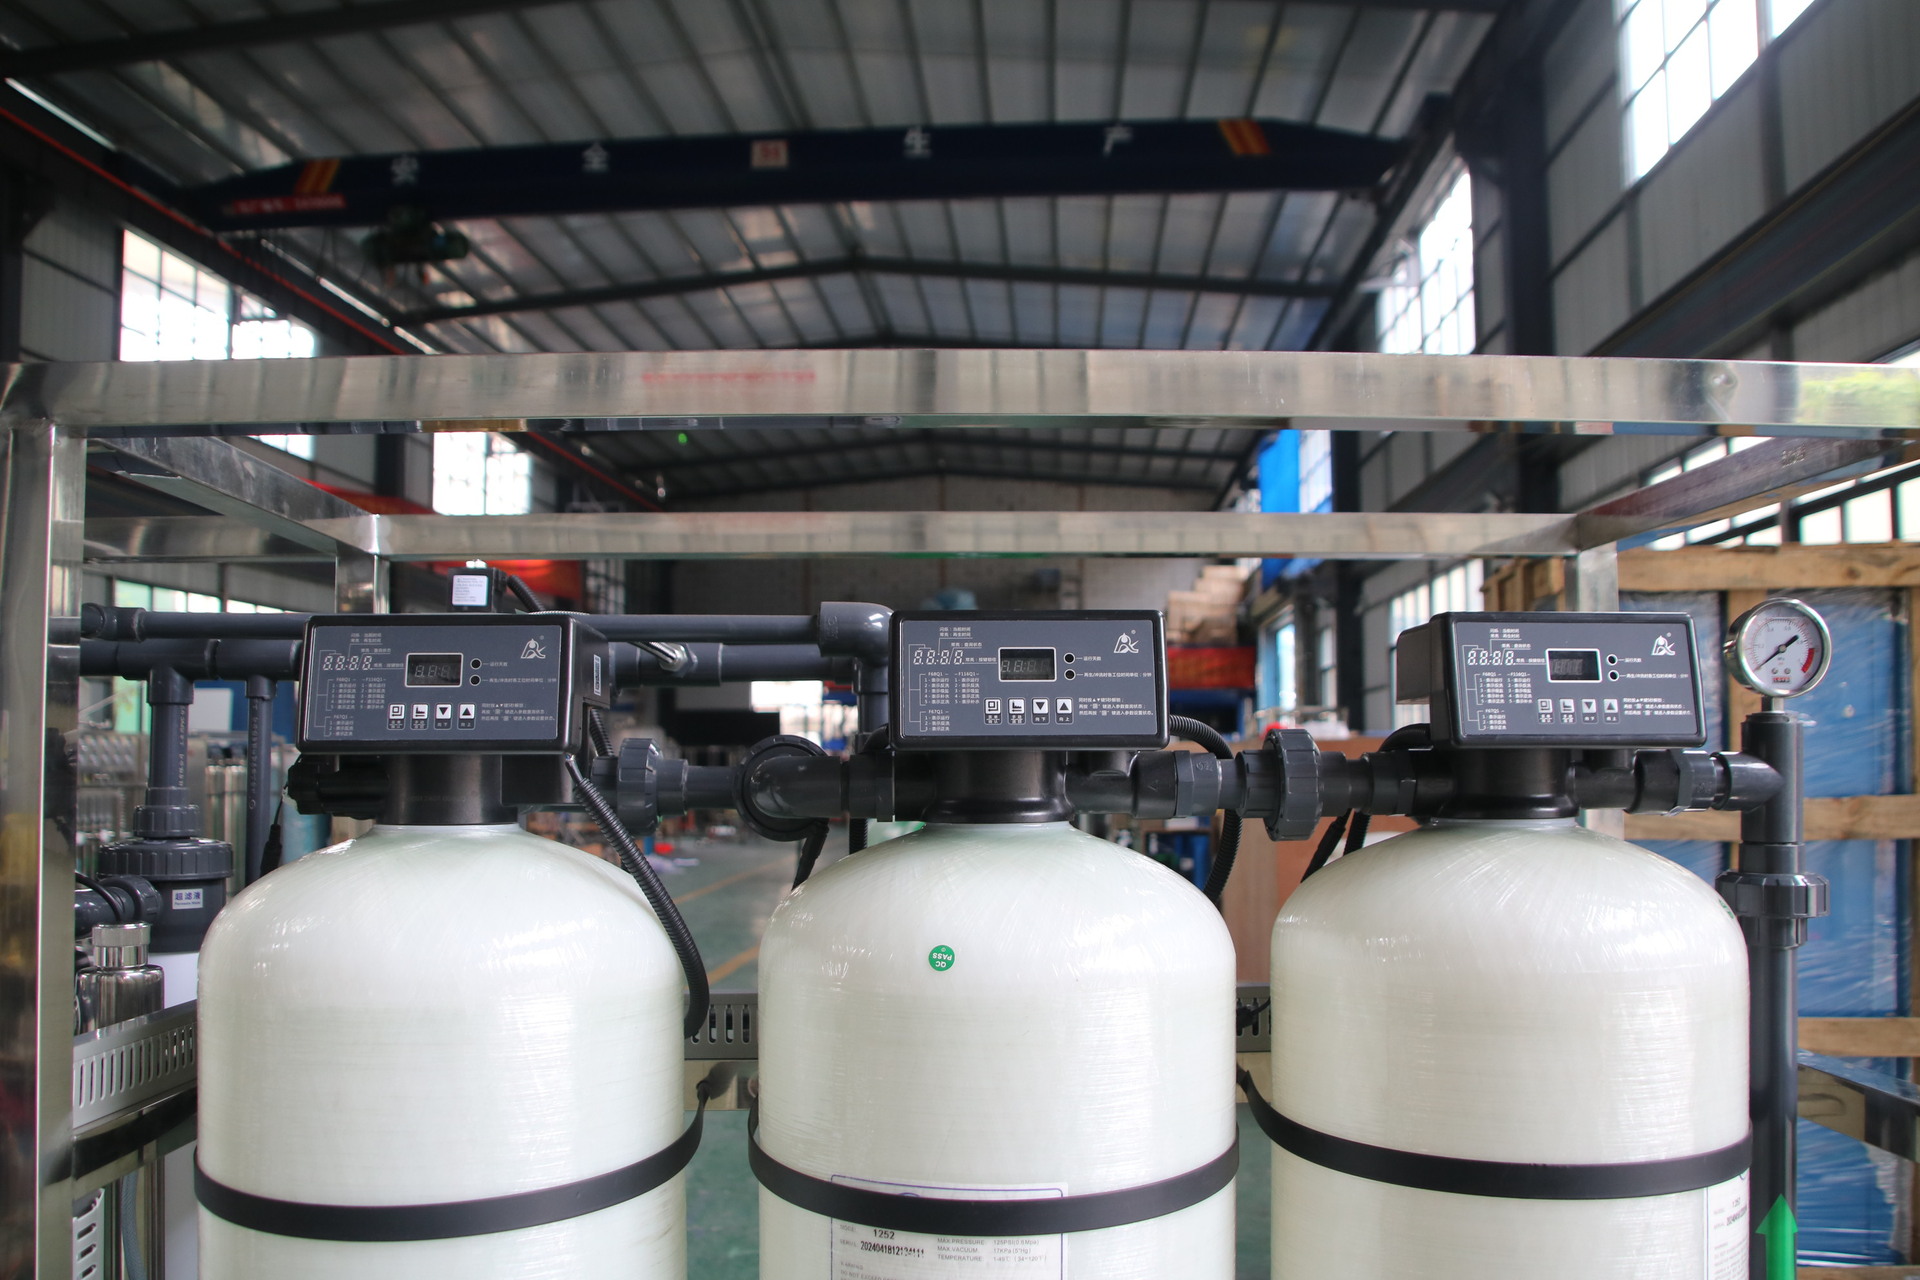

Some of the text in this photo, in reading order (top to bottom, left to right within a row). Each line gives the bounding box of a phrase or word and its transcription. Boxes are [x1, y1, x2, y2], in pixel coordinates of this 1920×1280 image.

[932, 952, 953, 961] PASS
[935, 960, 947, 968] QC
[873, 1229, 895, 1240] 1252
